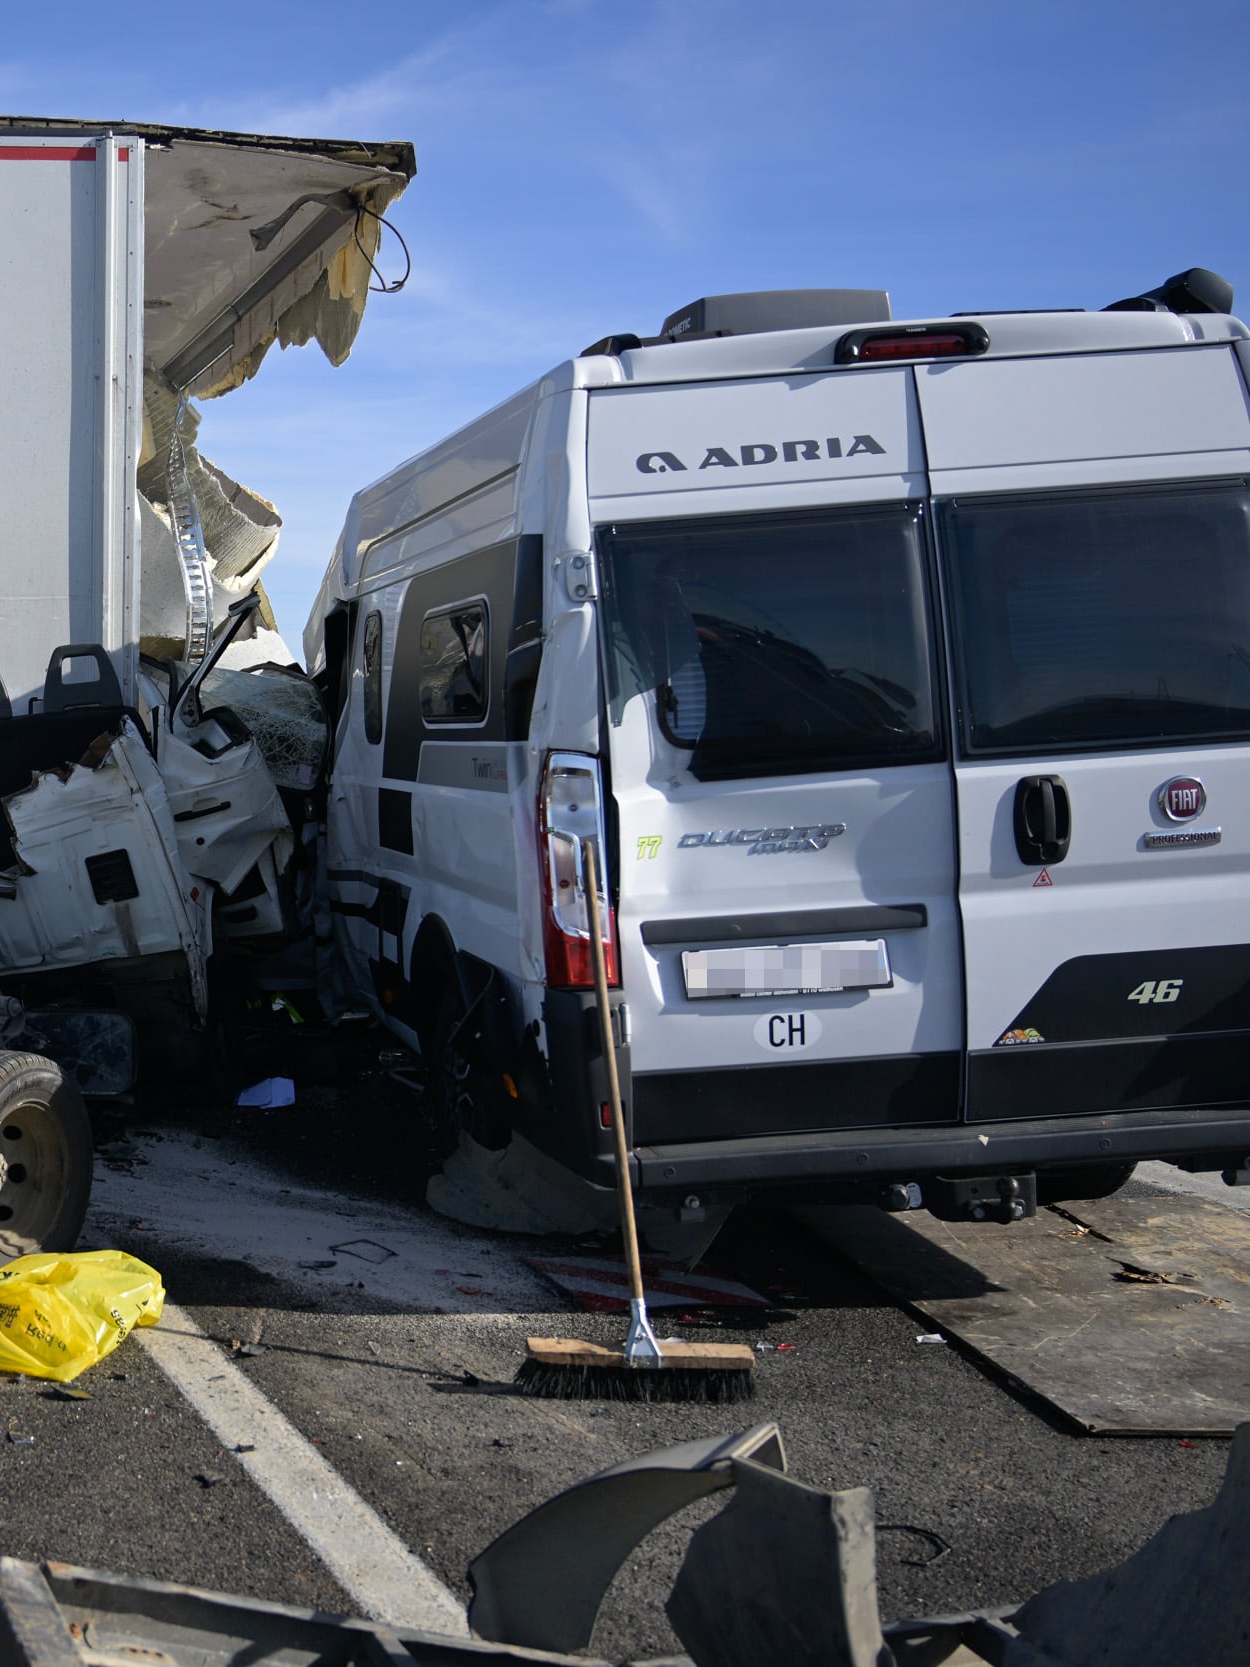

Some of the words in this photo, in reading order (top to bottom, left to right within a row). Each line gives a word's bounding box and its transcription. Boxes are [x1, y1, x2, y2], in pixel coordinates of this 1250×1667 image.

[698, 434, 887, 469] ADRIA
[1171, 788, 1198, 811] FIAT
[636, 835, 663, 860] 77
[676, 822, 847, 849] DUCATO
[1152, 831, 1217, 844] PROFESSIONAL
[1127, 979, 1184, 1005] 46
[768, 1013, 806, 1048] CH
